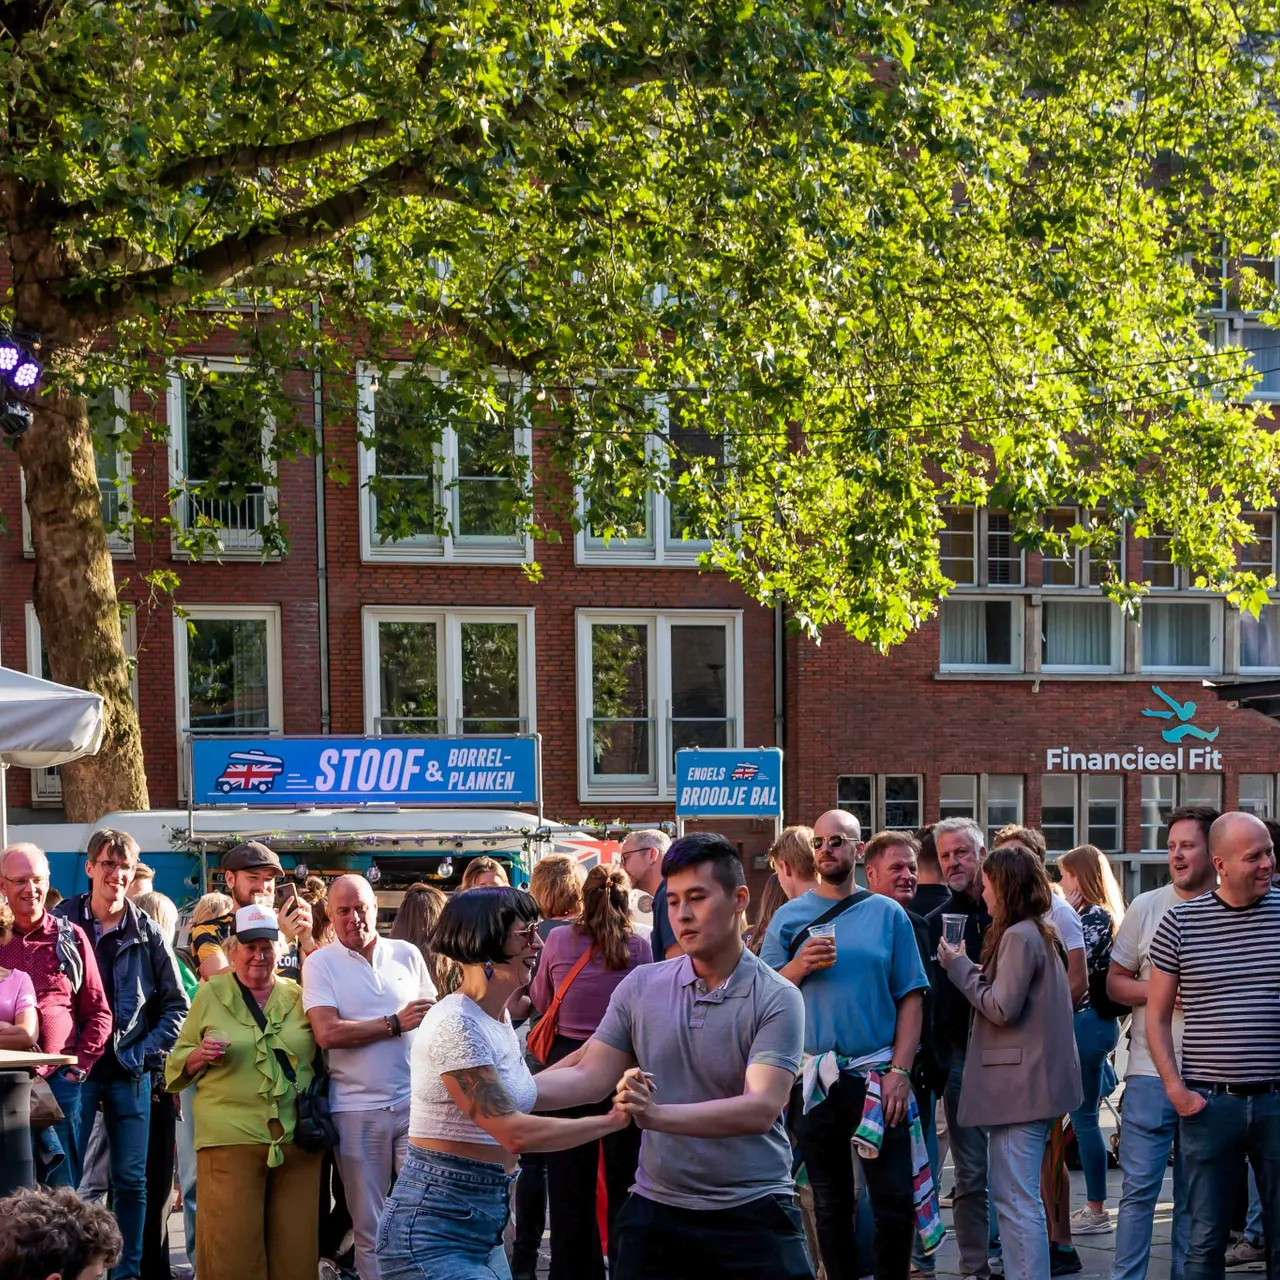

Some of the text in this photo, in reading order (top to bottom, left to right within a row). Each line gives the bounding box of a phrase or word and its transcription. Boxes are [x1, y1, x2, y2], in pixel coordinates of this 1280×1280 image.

[1046, 746, 1223, 771] Financieel Fit
[315, 748, 511, 791] STOOF & BORREL-
[687, 767, 726, 781] ENGELS
[448, 771, 515, 790] PLANKEN
[680, 786, 778, 806] BROODJE BAL
